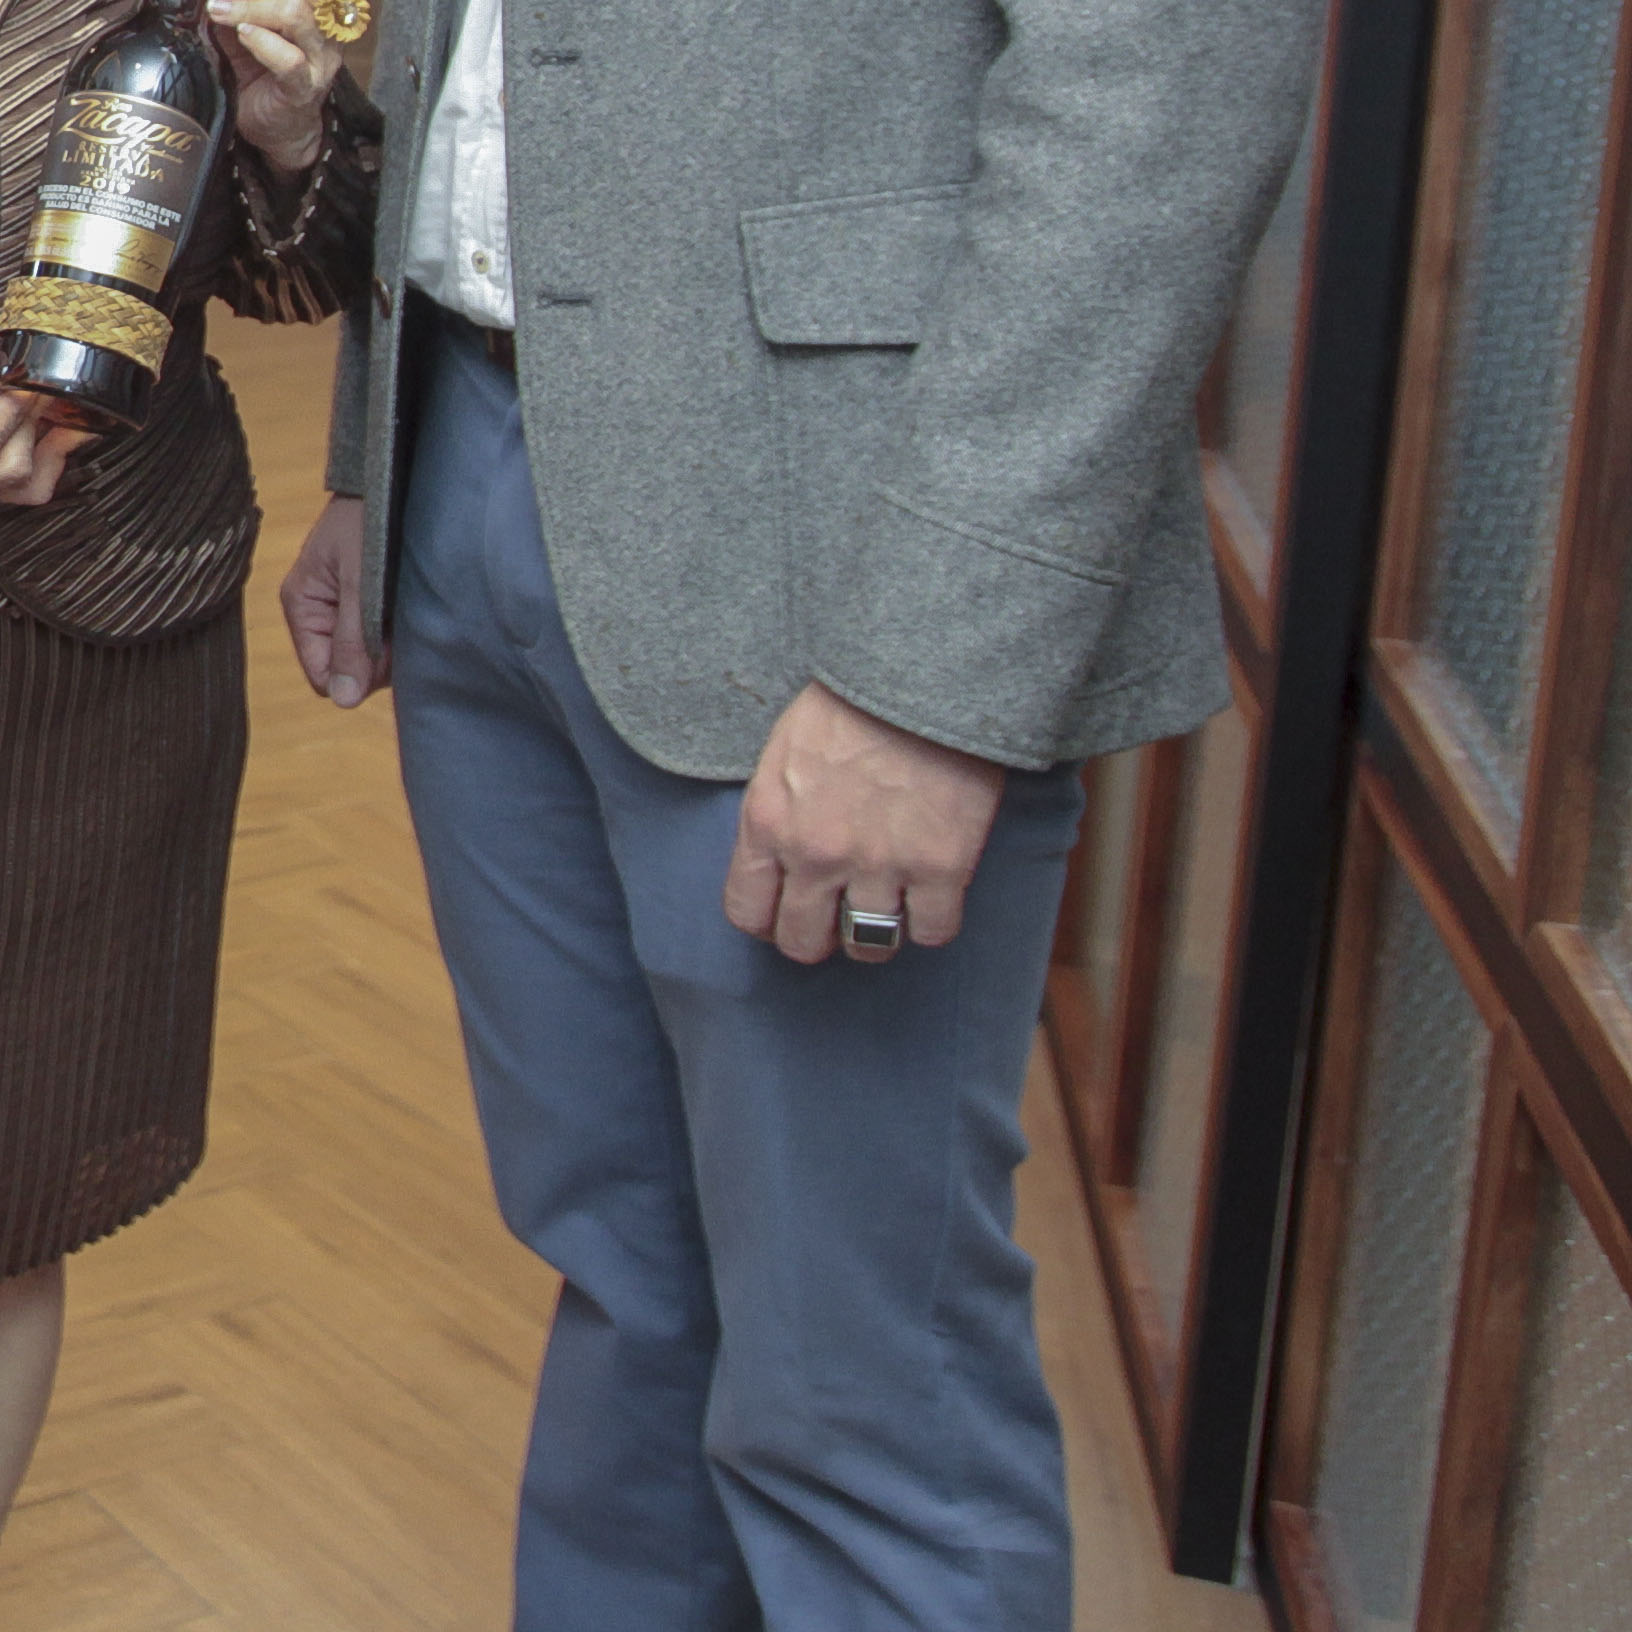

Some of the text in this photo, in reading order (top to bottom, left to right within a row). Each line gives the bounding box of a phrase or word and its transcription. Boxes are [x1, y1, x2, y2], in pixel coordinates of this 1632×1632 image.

[56, 98, 193, 155] Zacapa
[82, 187, 94, 197] EL
[146, 202, 160, 213] DE
[160, 207, 182, 223] ESTE
[132, 207, 158, 221] PARA
[158, 216, 170, 227] LA
